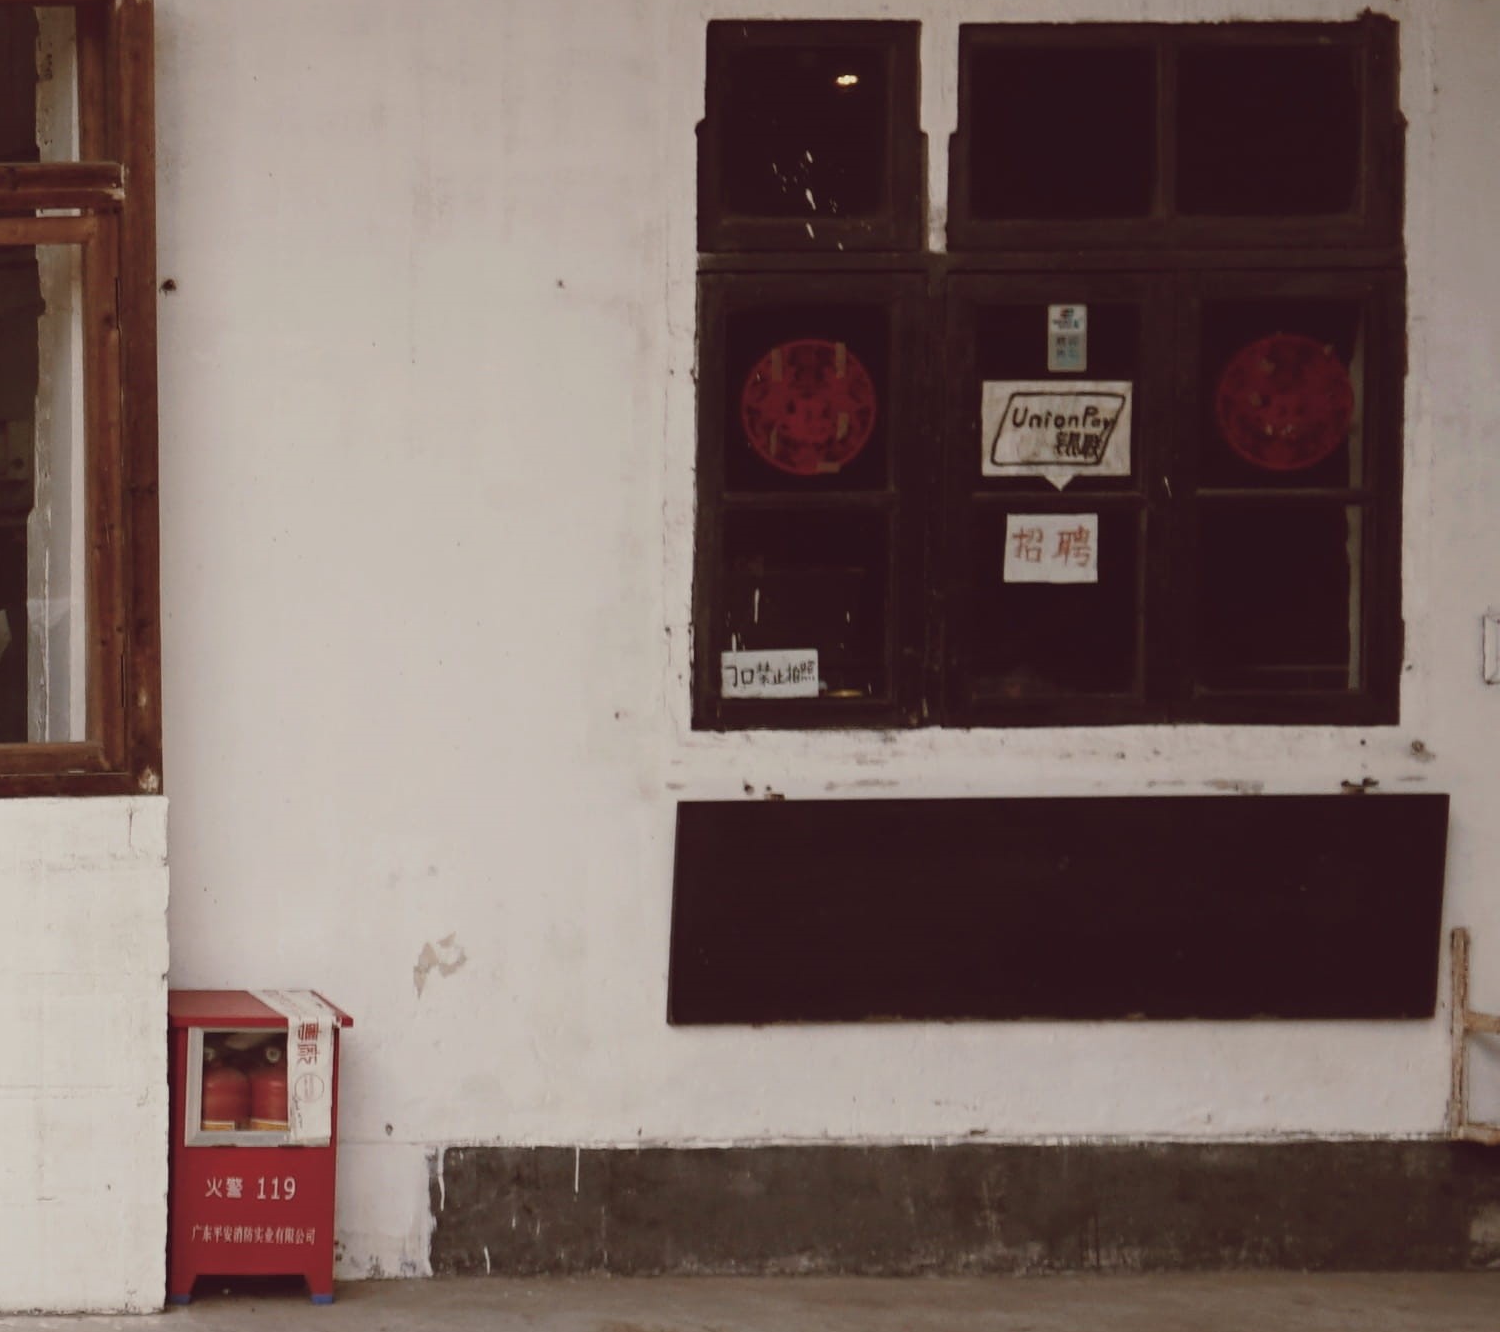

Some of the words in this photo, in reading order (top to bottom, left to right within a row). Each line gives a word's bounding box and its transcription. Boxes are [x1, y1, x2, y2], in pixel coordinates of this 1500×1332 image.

[1011, 524, 1092, 567] 招聘
[205, 1177, 243, 1198] 火警
[256, 1177, 296, 1200] 119
